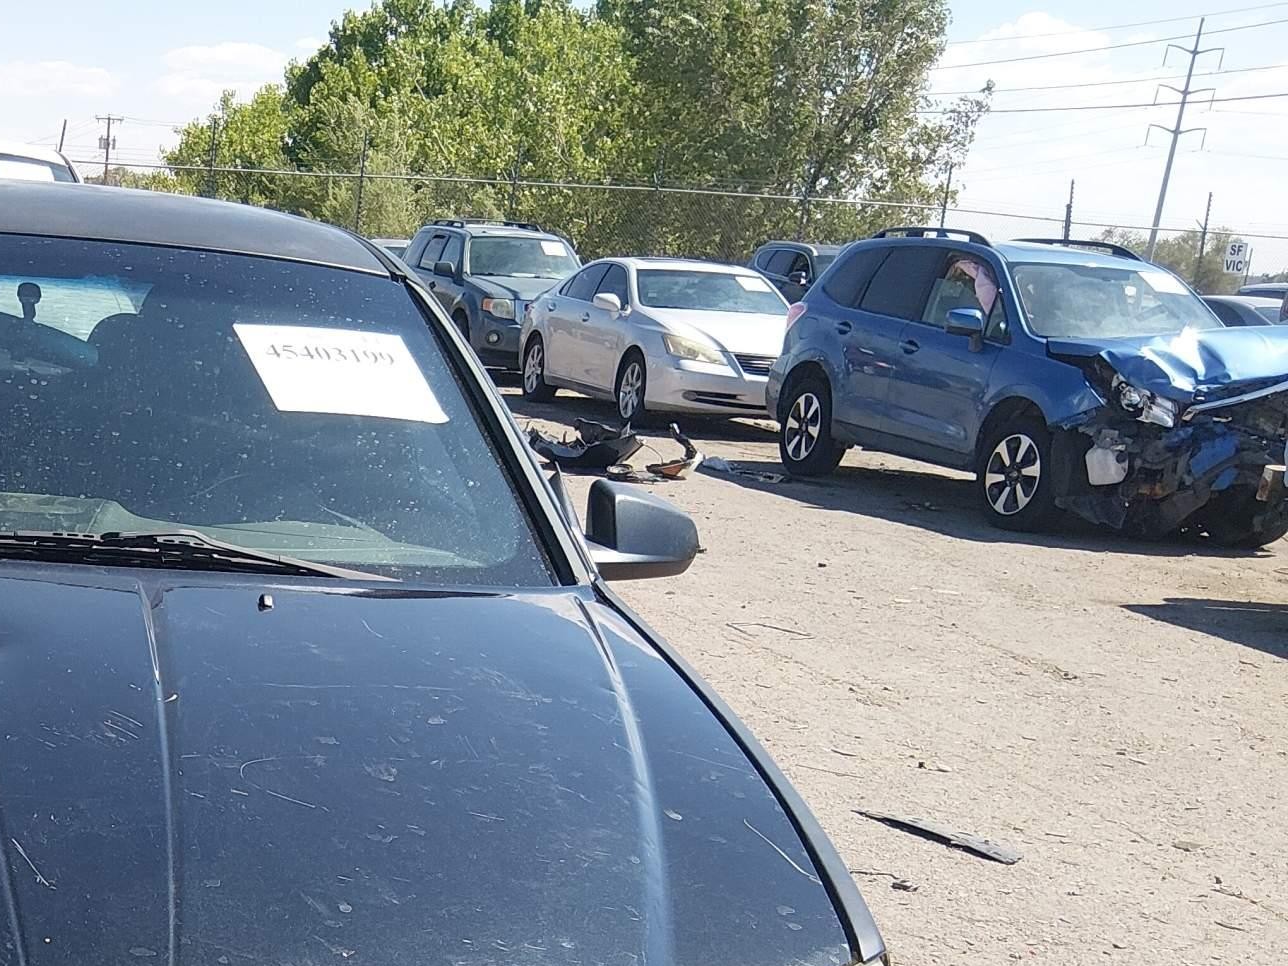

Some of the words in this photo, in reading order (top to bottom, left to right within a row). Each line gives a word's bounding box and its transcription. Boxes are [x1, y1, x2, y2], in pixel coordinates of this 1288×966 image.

[1229, 244, 1244, 256] SF
[1225, 259, 1243, 272] VIC
[265, 343, 395, 366] 45403199
